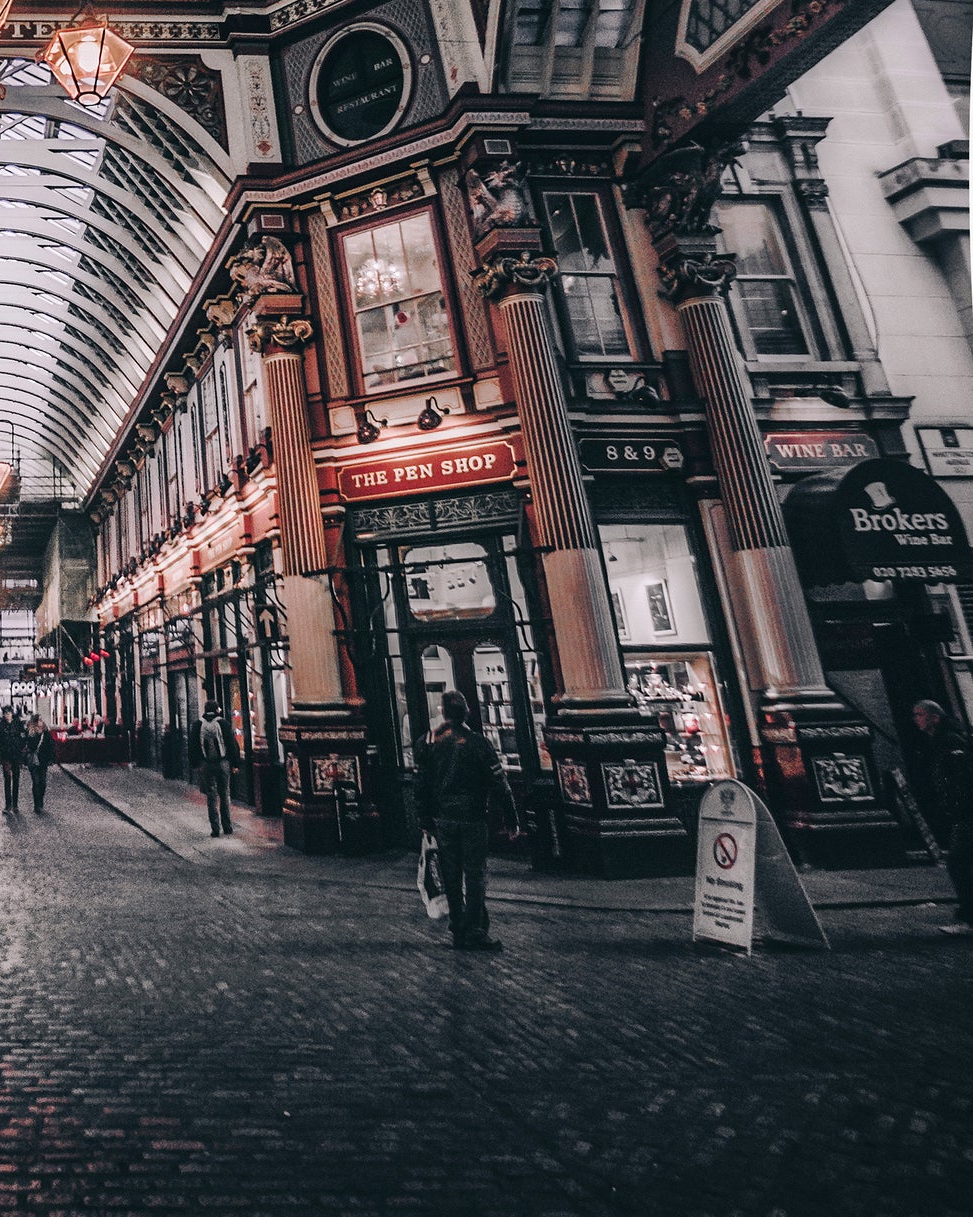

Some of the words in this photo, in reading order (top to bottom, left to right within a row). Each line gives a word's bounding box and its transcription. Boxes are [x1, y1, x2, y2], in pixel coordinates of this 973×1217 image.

[374, 59, 393, 71] BAR
[606, 445, 619, 461] 8
[623, 445, 639, 461] &
[643, 445, 656, 461] 9
[774, 443, 827, 458] WINE
[829, 443, 869, 457] BAR
[351, 470, 388, 488] THE
[392, 463, 434, 482] PEN
[440, 453, 497, 476] SHOP
[849, 507, 950, 532] Brokers
[894, 534, 928, 546] Wine
[931, 534, 953, 545] Bar
